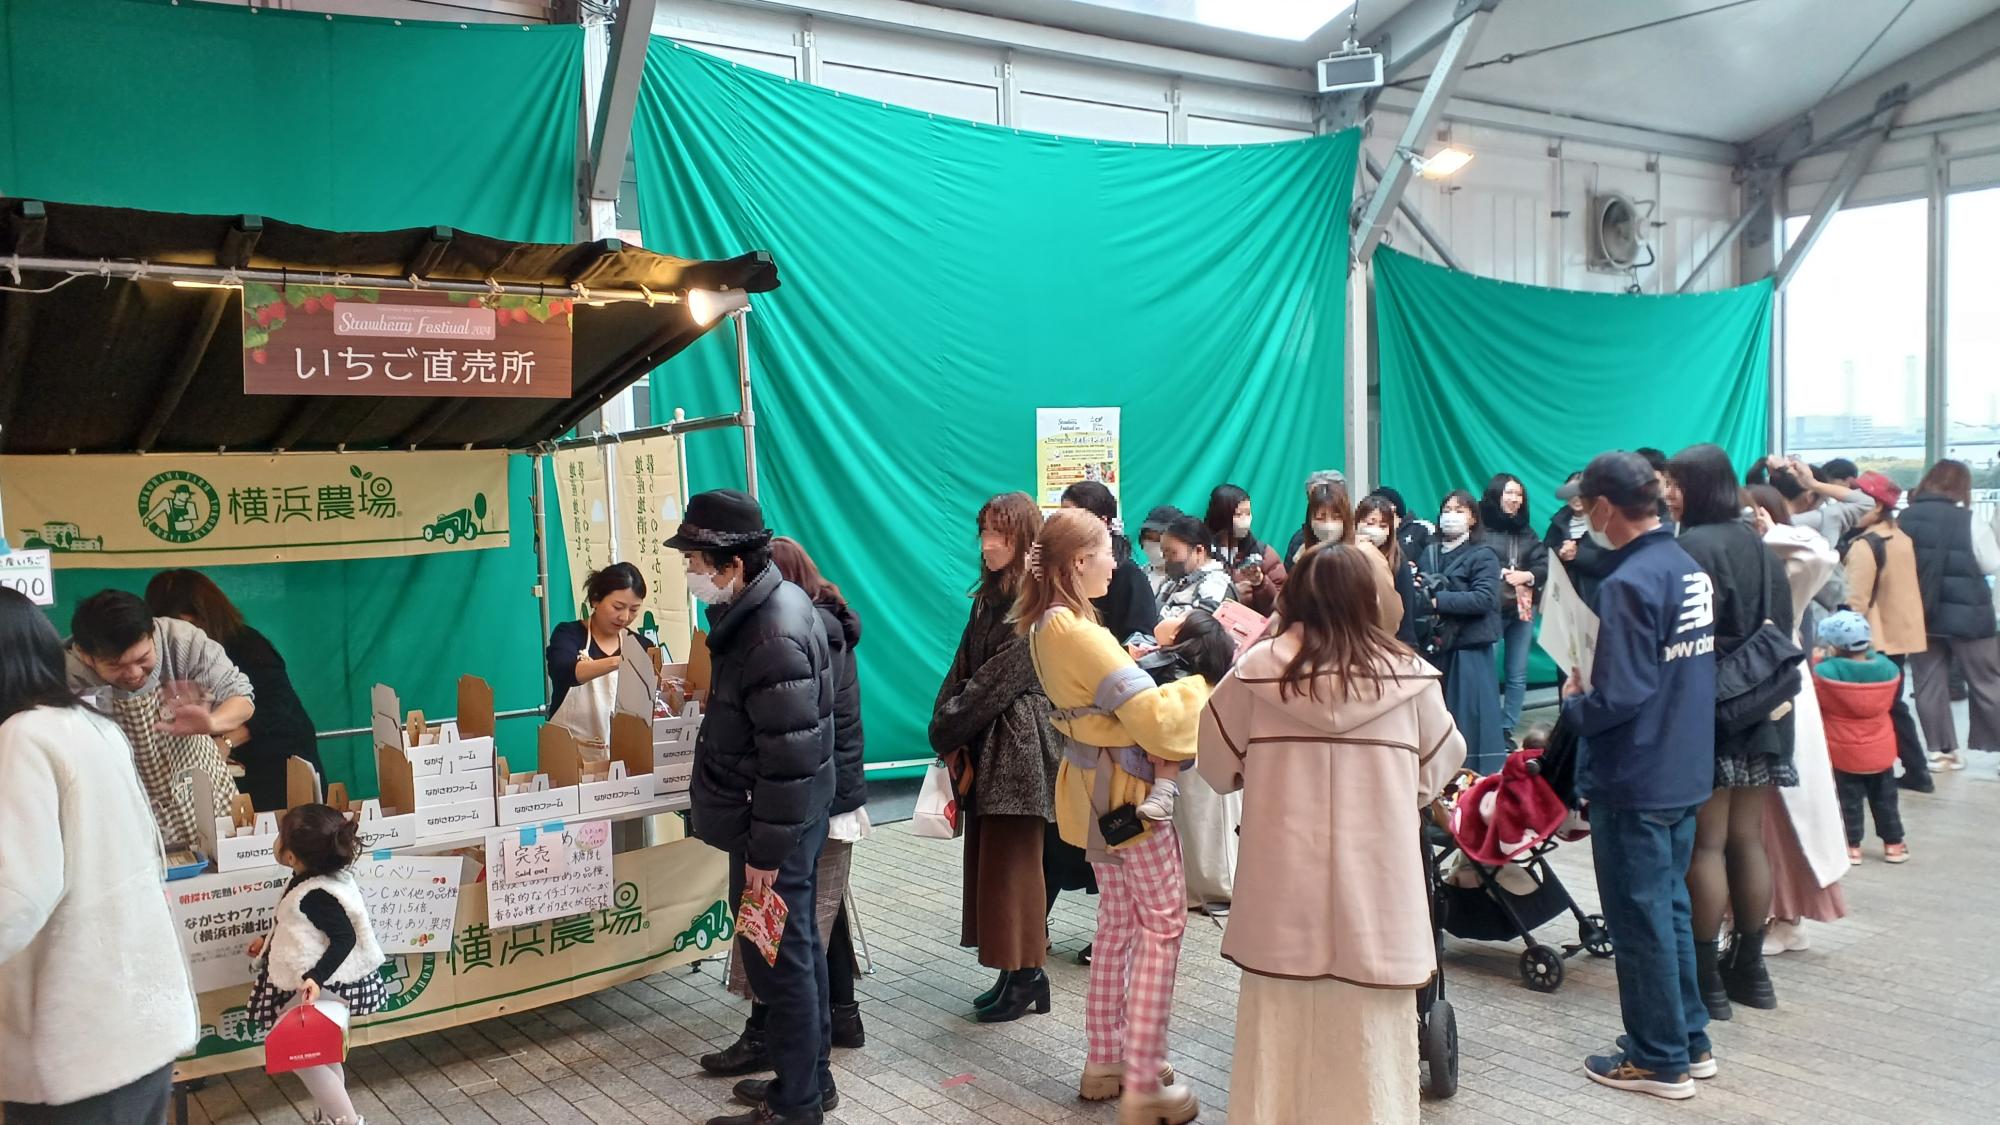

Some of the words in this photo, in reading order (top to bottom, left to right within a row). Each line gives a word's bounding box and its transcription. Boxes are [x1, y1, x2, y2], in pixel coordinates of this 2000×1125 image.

[339, 312, 412, 333] Strawberry
[416, 316, 470, 335] Festival
[471, 325, 491, 336] 2024
[295, 346, 536, 385] いちご直売所
[227, 476, 396, 525] 横浜農場
[425, 781, 478, 796] ながさわファーム
[594, 787, 640, 801] ながさわファーム
[427, 809, 480, 825] ながさわファーム
[514, 799, 564, 814] ながさわファーム
[514, 845, 551, 867] 完売
[514, 867, 531, 879] Sold
[534, 867, 548, 876] out
[184, 906, 275, 931] ながさわファー
[193, 918, 273, 944] （横浜市港北
